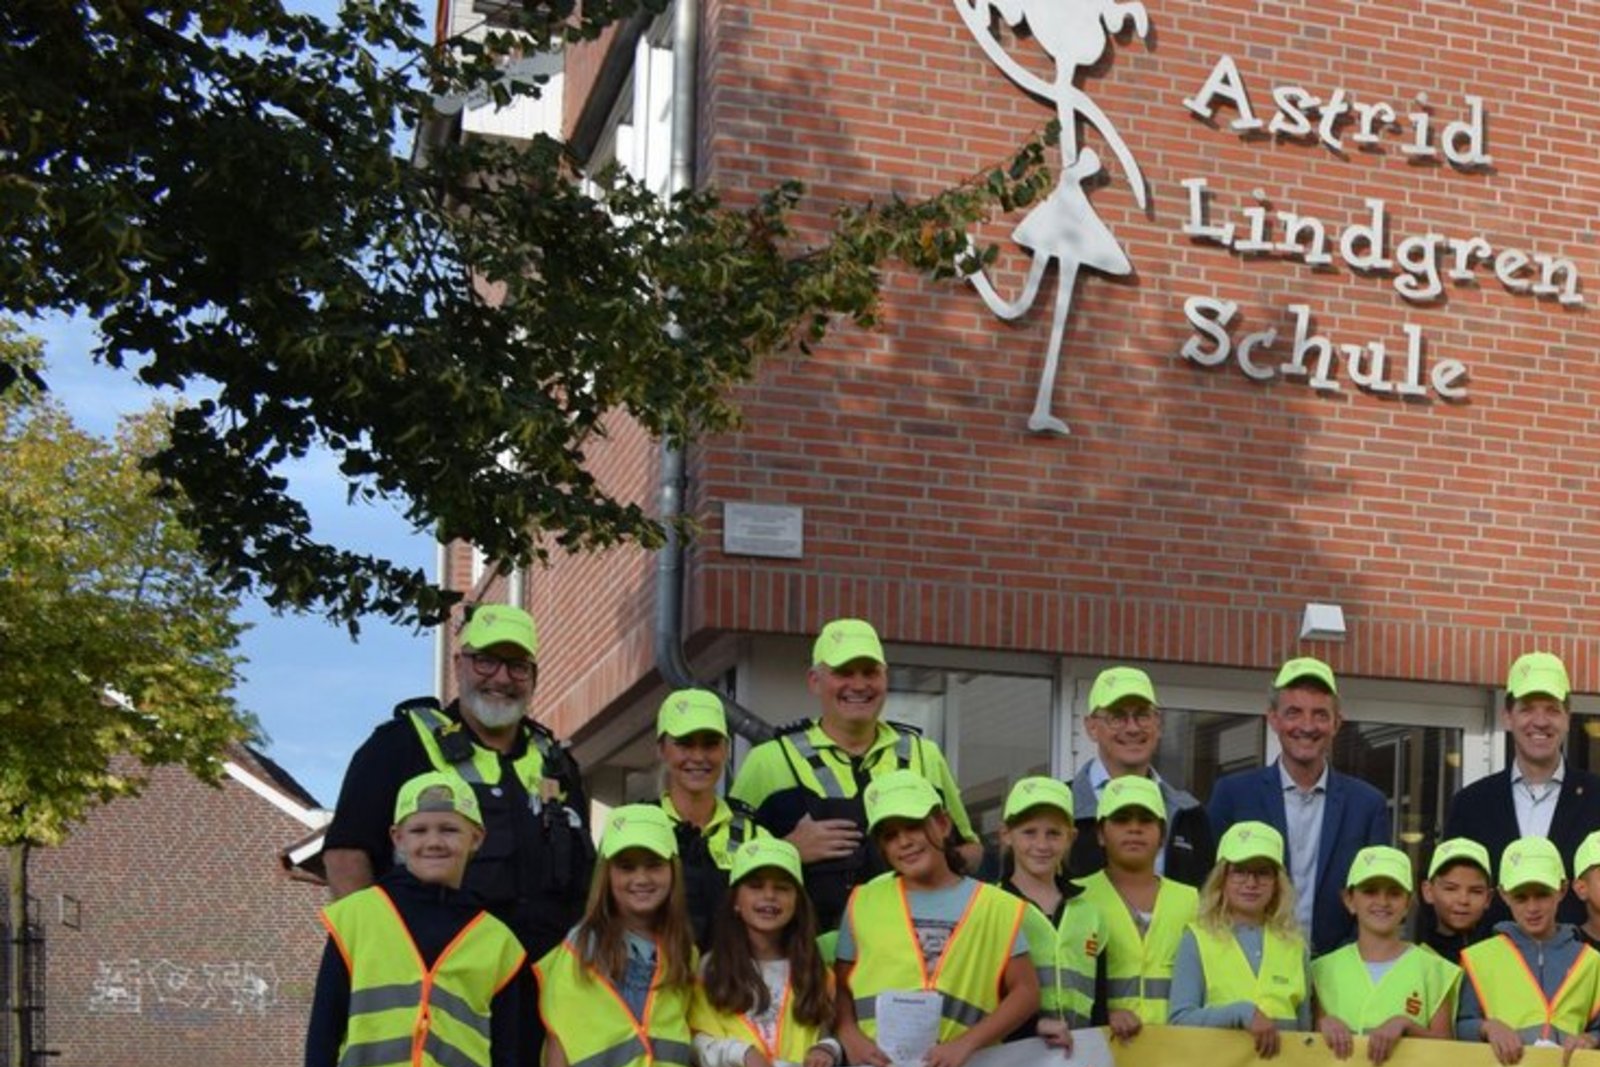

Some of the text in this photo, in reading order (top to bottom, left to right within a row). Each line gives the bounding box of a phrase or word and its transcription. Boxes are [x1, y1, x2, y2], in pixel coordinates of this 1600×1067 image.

[1181, 54, 1492, 168] Astrid
[1179, 177, 1585, 306] Lindgren
[1180, 296, 1471, 399] Schule
